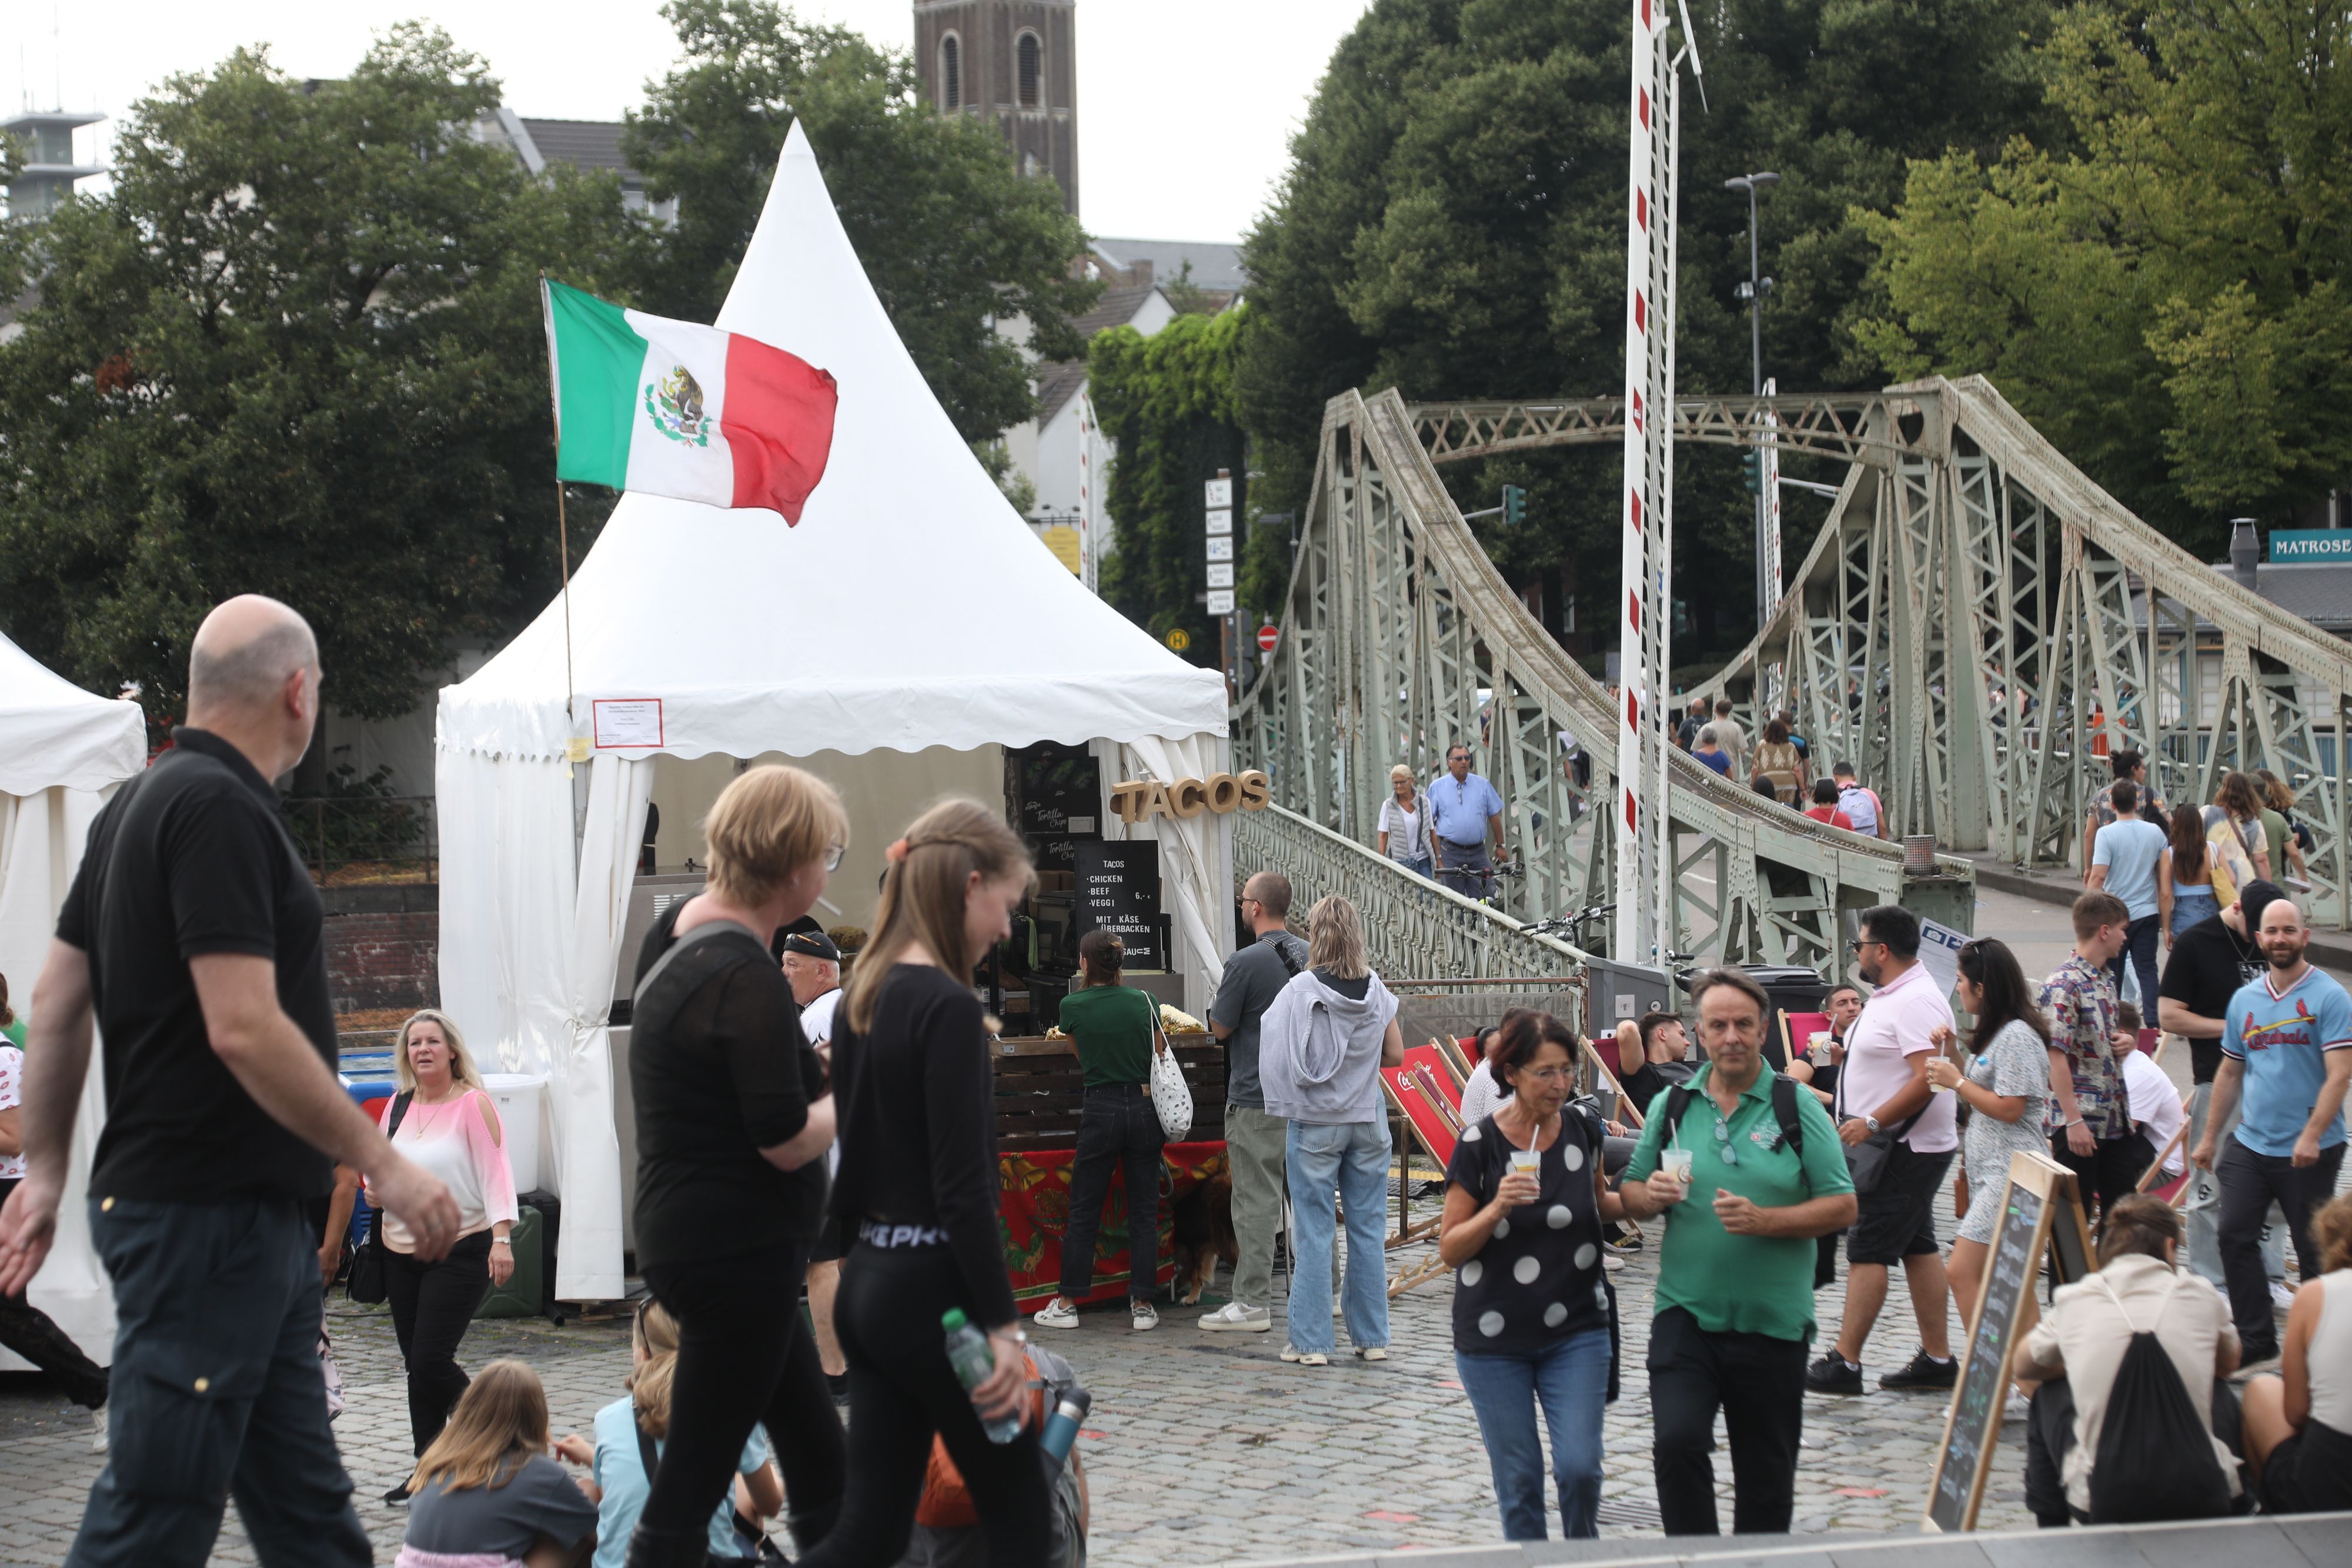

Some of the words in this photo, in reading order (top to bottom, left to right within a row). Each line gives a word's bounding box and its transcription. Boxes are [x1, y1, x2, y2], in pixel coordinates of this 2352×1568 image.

[1111, 769, 1270, 823] TACOS
[1035, 808, 1064, 822] Tortilla
[1050, 819, 1067, 828] Chips
[1047, 841, 1075, 854] Tortilla
[1103, 860, 1124, 868] TACOS
[1091, 899, 1114, 907] VEGGI
[1119, 914, 1140, 923] KÄSE
[1101, 924, 1150, 933] ÜBERBACKEN
[2248, 1025, 2311, 1051] Cardinals
